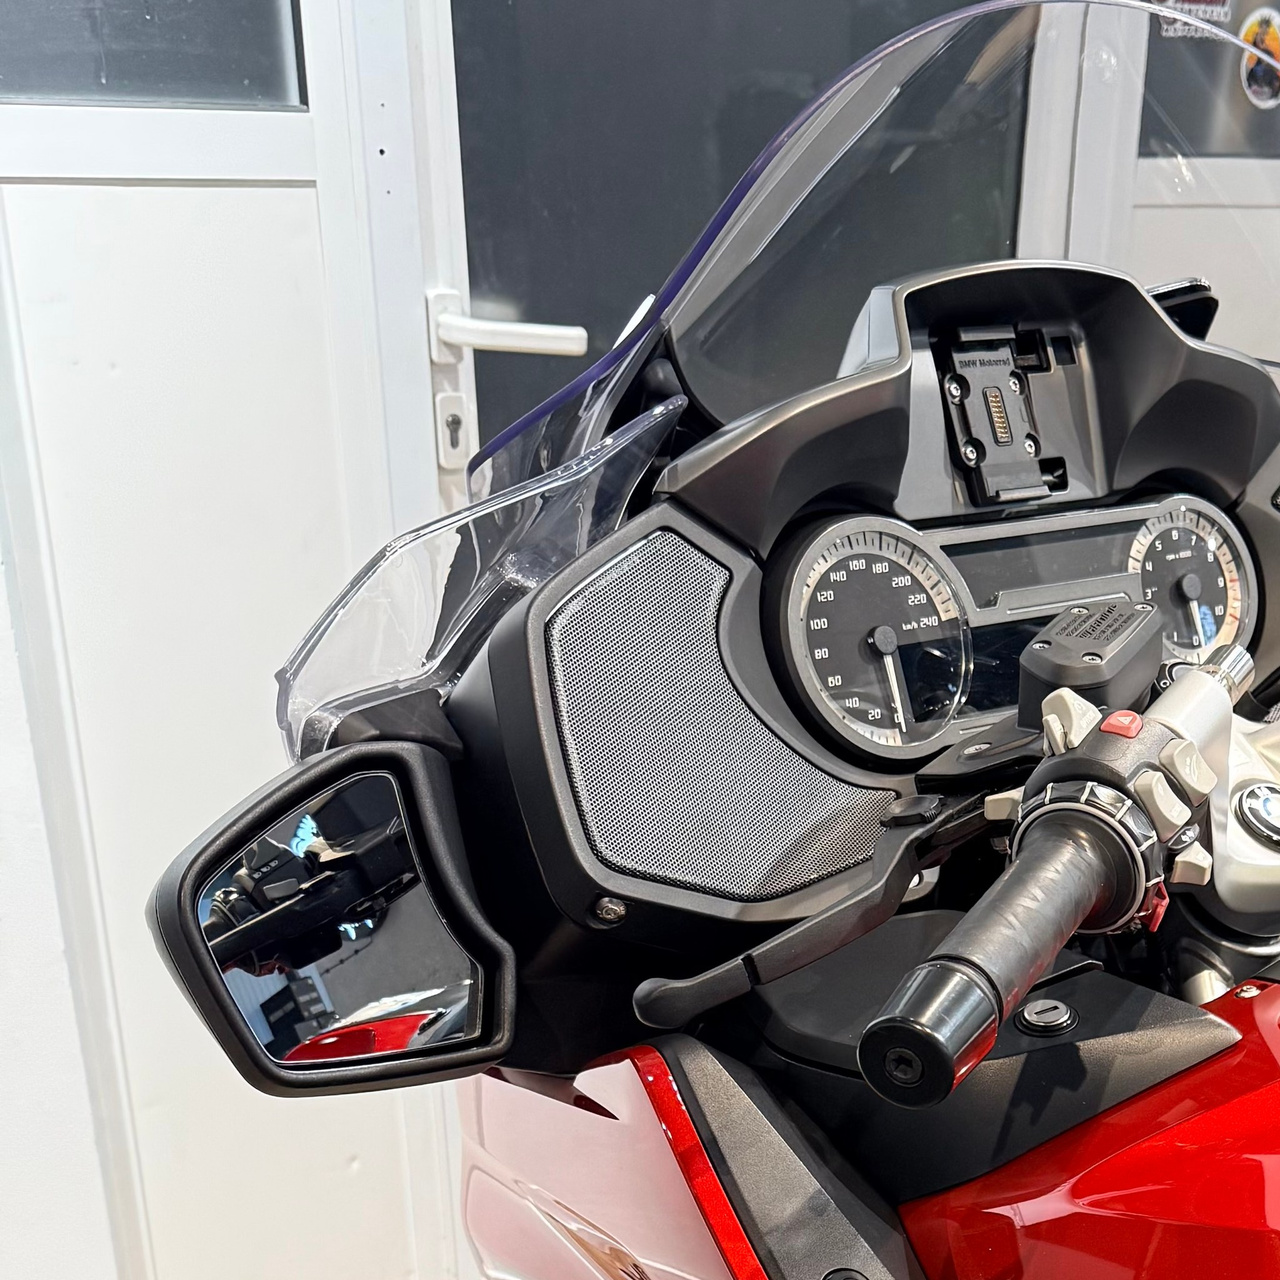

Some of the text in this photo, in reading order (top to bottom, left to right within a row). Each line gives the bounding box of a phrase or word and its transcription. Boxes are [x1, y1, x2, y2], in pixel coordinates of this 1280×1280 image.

[959, 357, 1010, 369] BMW Motorrad
[1171, 530, 1179, 540] 6
[1191, 535, 1197, 546] 7
[1155, 540, 1162, 551] 5
[1207, 552, 1214, 562] 8
[849, 559, 866, 571] 160
[872, 562, 889, 574] 180
[1145, 561, 1153, 571] 4
[830, 570, 847, 582] 140
[892, 575, 912, 588] 200
[1217, 577, 1224, 587] 9
[817, 590, 834, 602] 120
[908, 594, 927, 606] 220
[1145, 589, 1152, 600] 3
[1215, 605, 1224, 615] 10
[810, 618, 828, 630] 100
[920, 616, 939, 628] 240
[1192, 635, 1199, 646] 0
[814, 648, 829, 660] 80
[827, 675, 842, 687] 60
[845, 697, 860, 708] 40
[868, 708, 881, 720] 20
